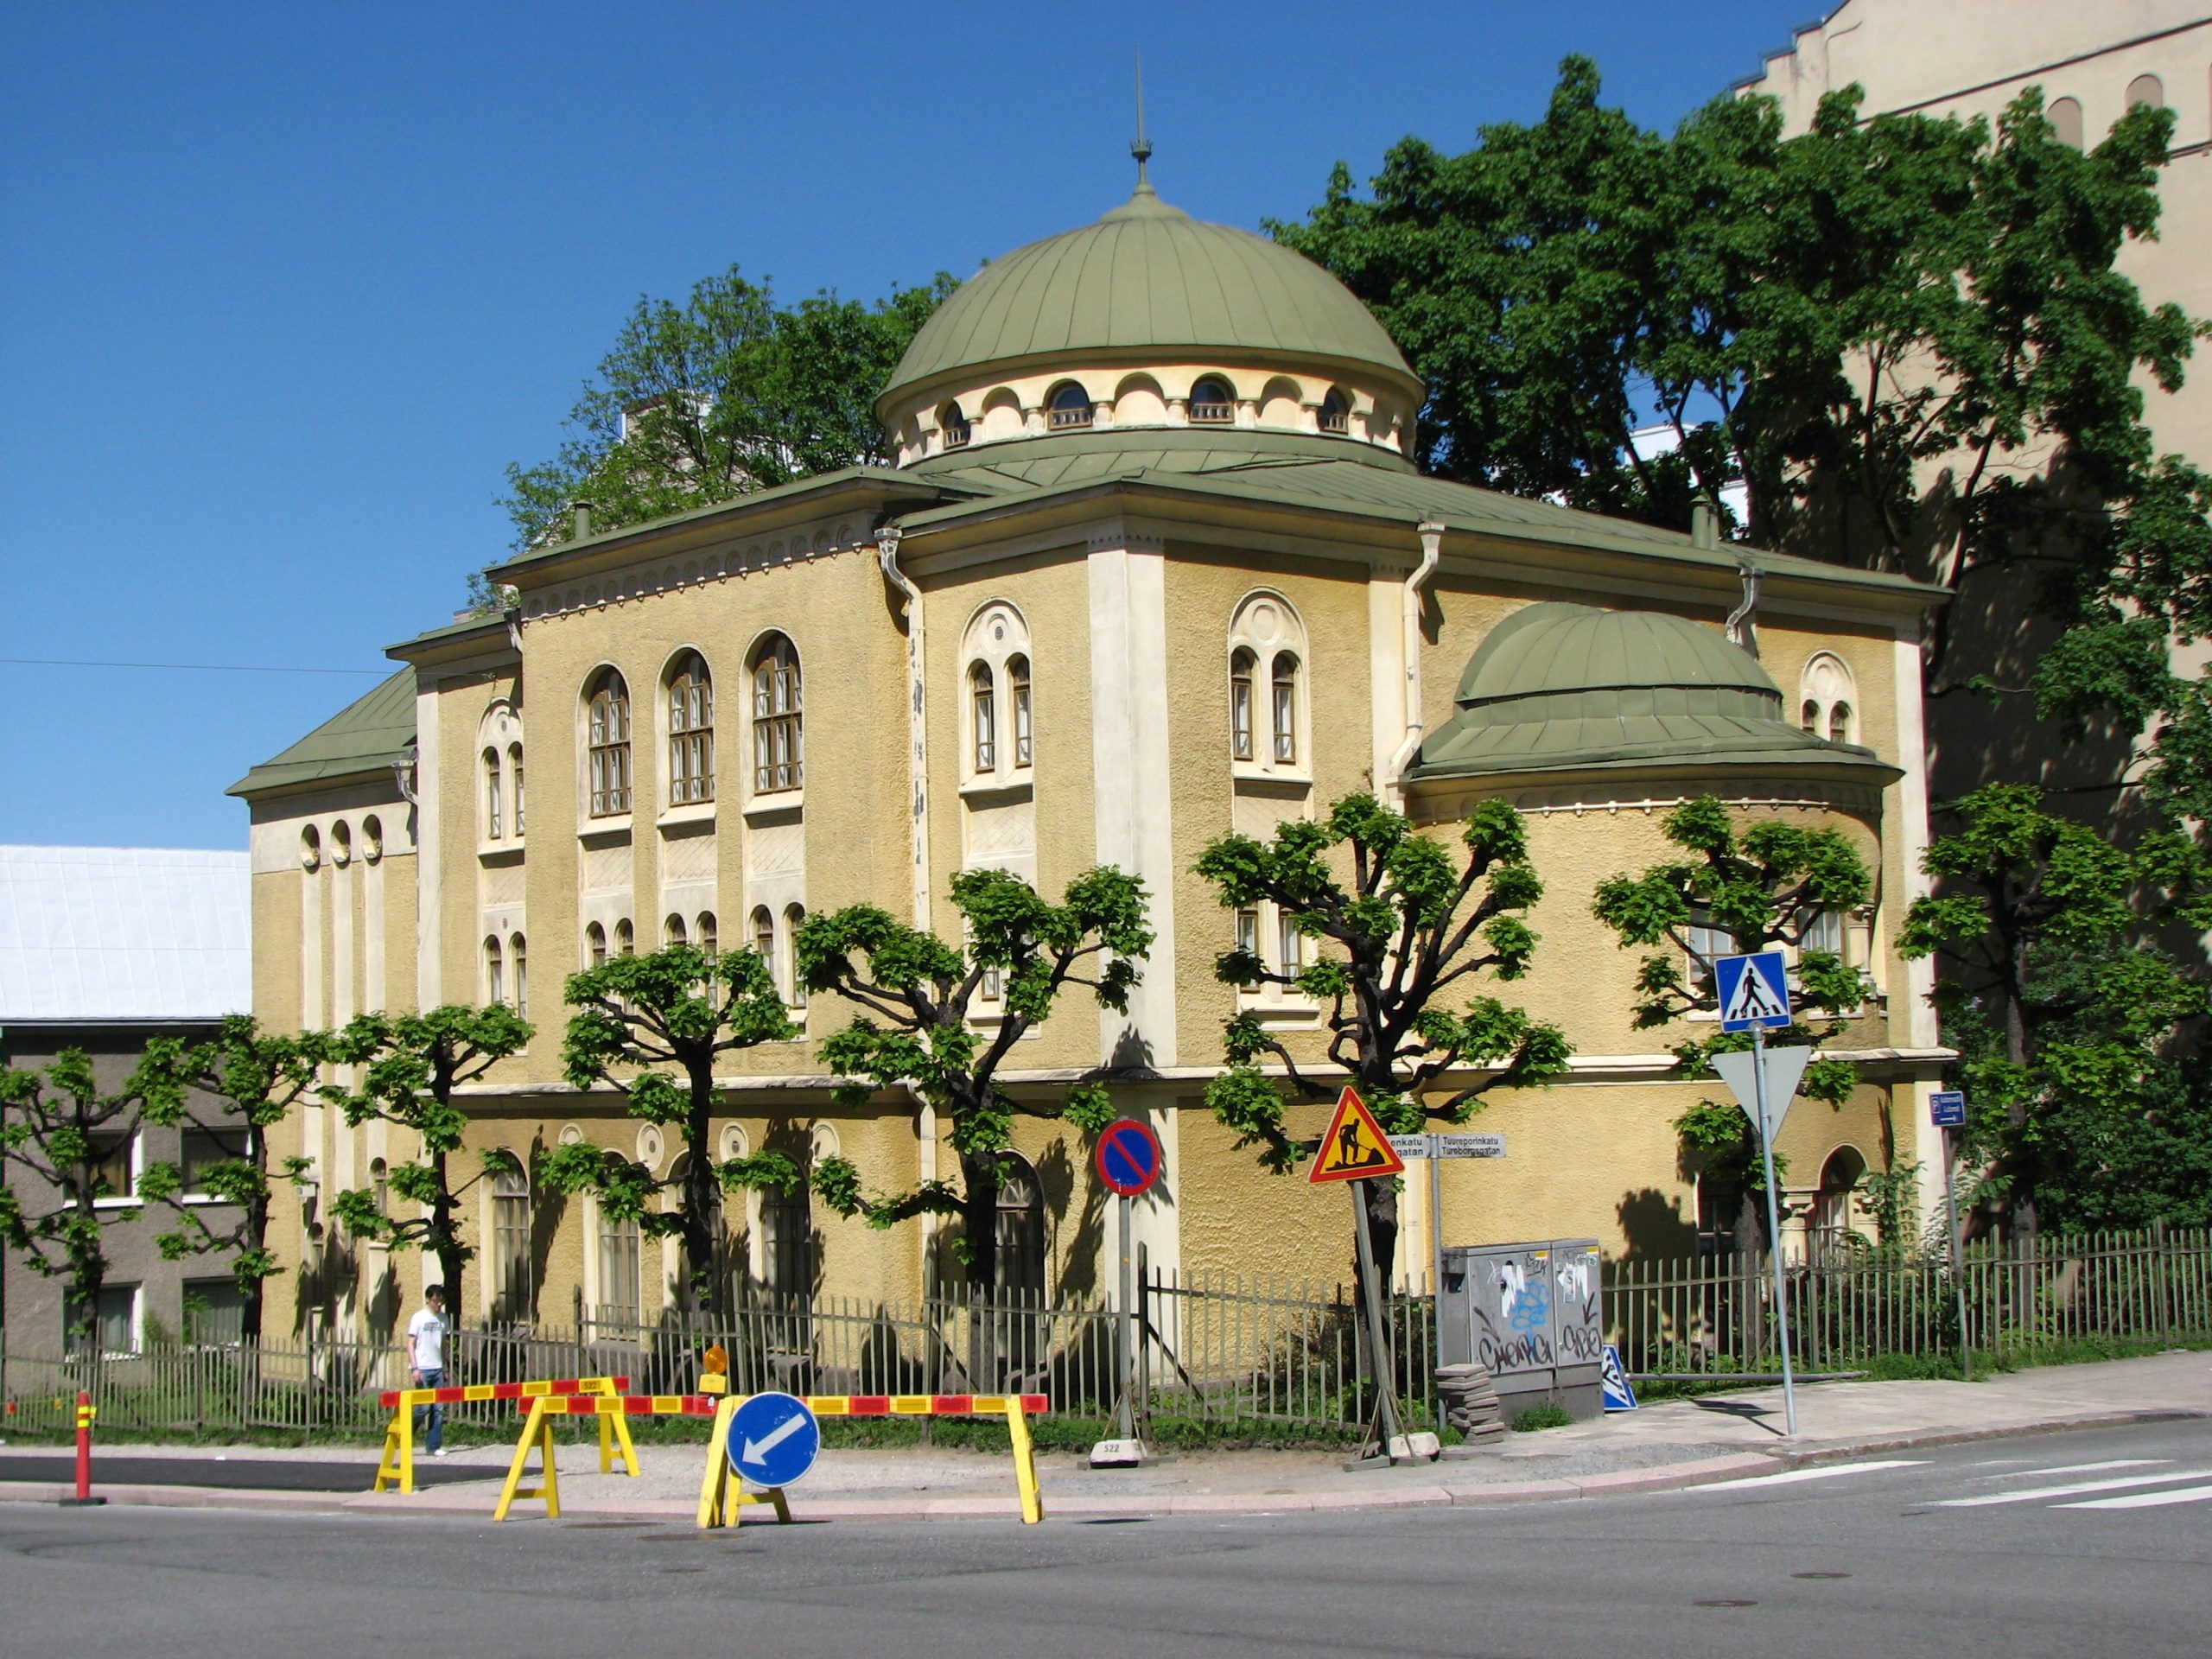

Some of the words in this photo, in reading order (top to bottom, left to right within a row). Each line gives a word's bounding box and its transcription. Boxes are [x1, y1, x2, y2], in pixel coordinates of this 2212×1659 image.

[1390, 1137, 1423, 1147] enkatu
[1442, 1136, 1499, 1147] Tuureporinkatu
[1396, 1147, 1424, 1157] gatan
[1441, 1147, 1501, 1156] Tureborgsgatan
[1104, 1444, 1120, 1452] 522
